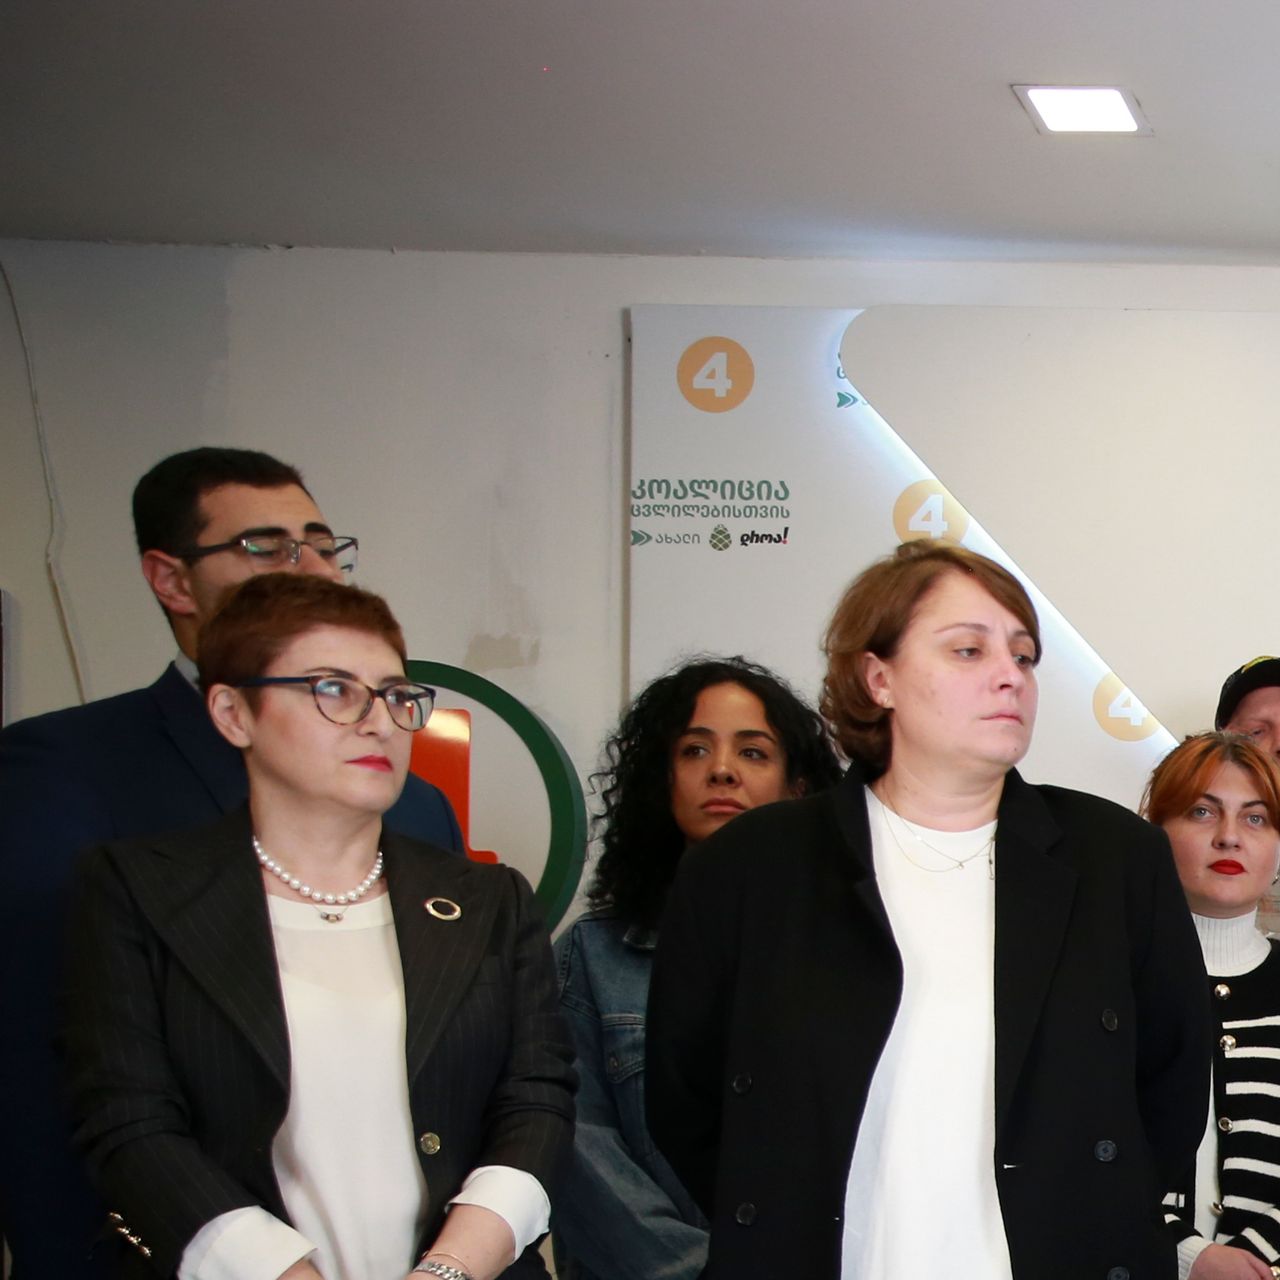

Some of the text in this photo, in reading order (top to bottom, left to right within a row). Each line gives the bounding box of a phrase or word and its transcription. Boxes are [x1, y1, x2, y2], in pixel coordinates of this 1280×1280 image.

[692, 351, 733, 398] 4
[630, 479, 790, 501] კოალიცია
[630, 503, 790, 519] ცვლილებისთვის
[908, 493, 948, 539] 4
